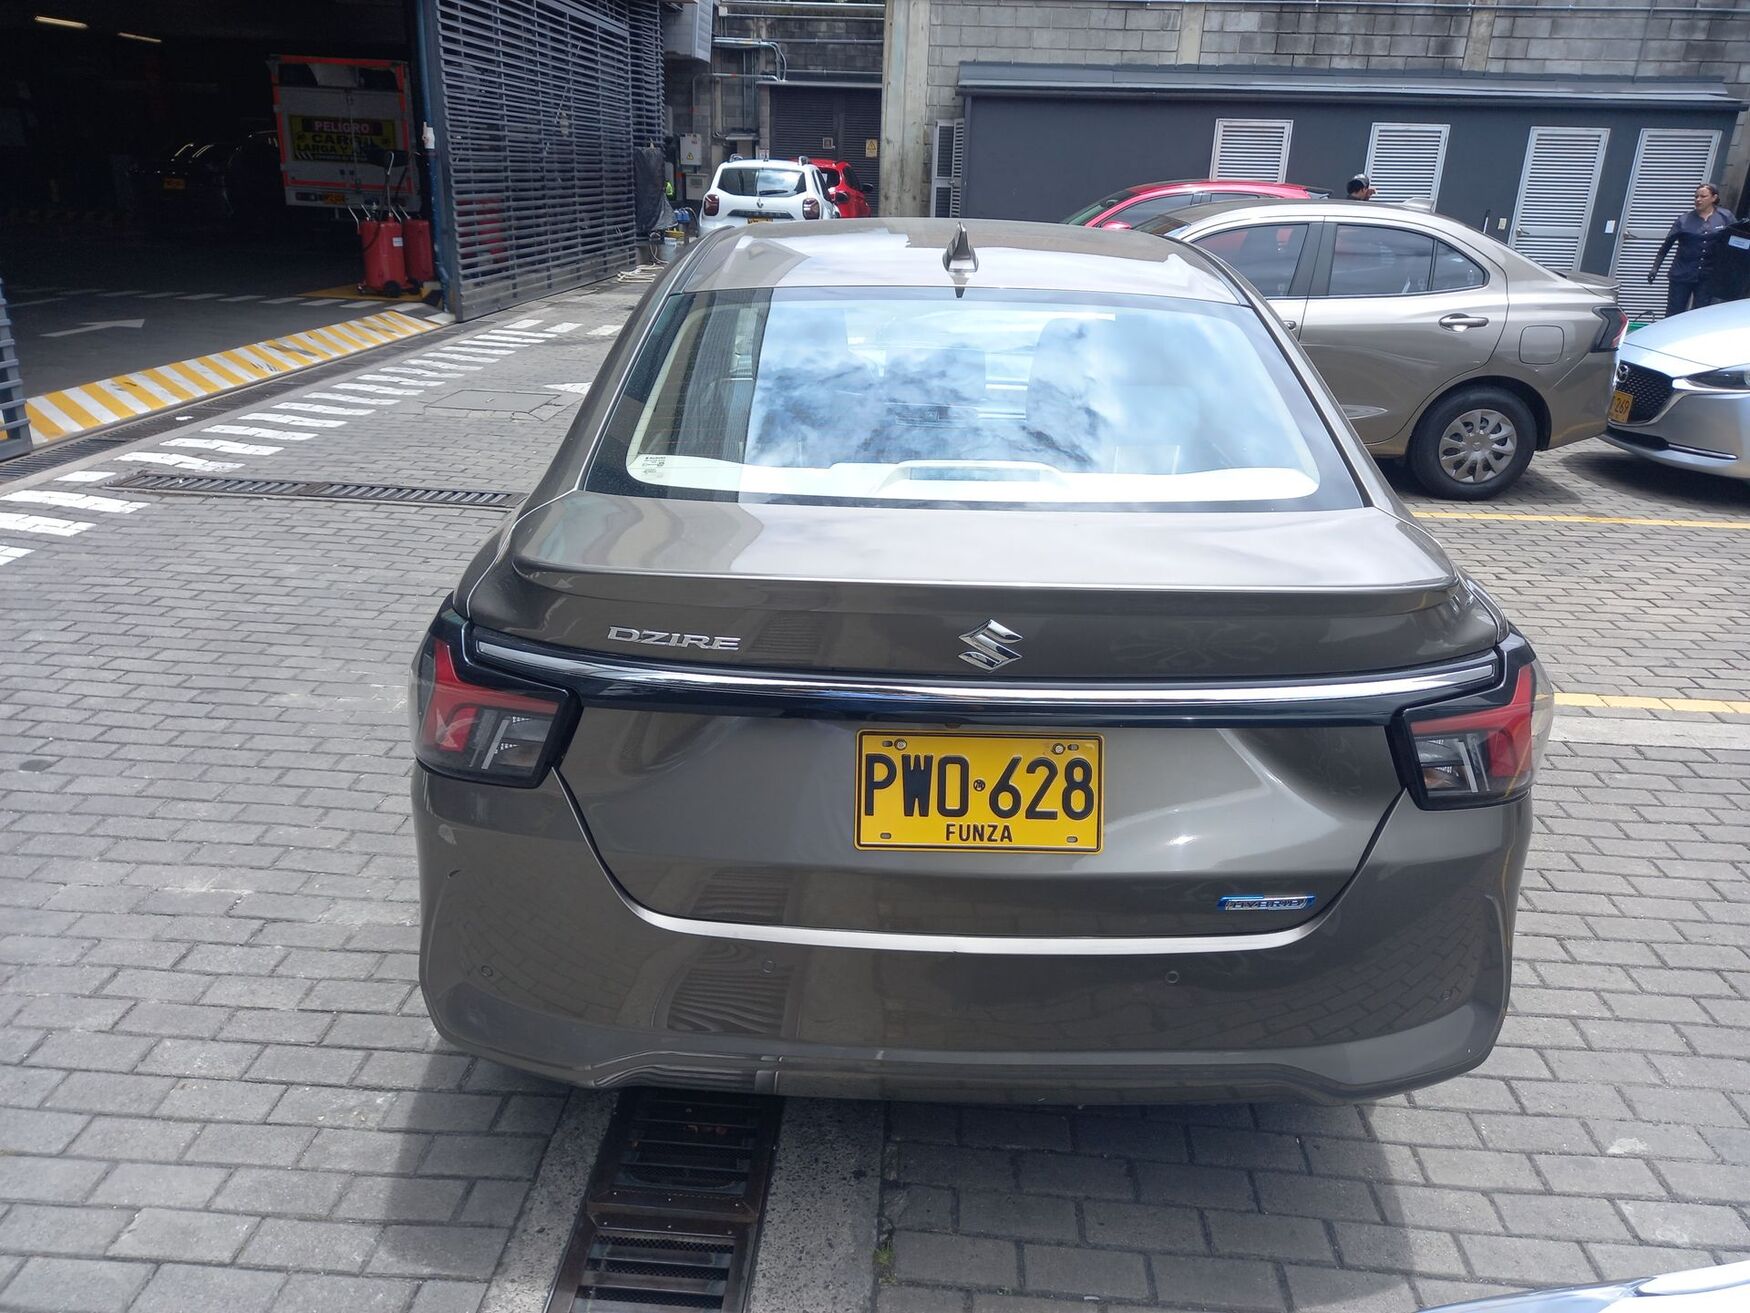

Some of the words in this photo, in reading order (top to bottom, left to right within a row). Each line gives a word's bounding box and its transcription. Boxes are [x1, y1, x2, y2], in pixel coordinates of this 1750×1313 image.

[314, 120, 370, 133] PELIGRO
[296, 143, 337, 153] LARGA
[340, 144, 349, 153] Y
[607, 626, 742, 651] DZIRE
[945, 823, 1013, 843] FUNZA
[1230, 899, 1302, 910] HYBRID
